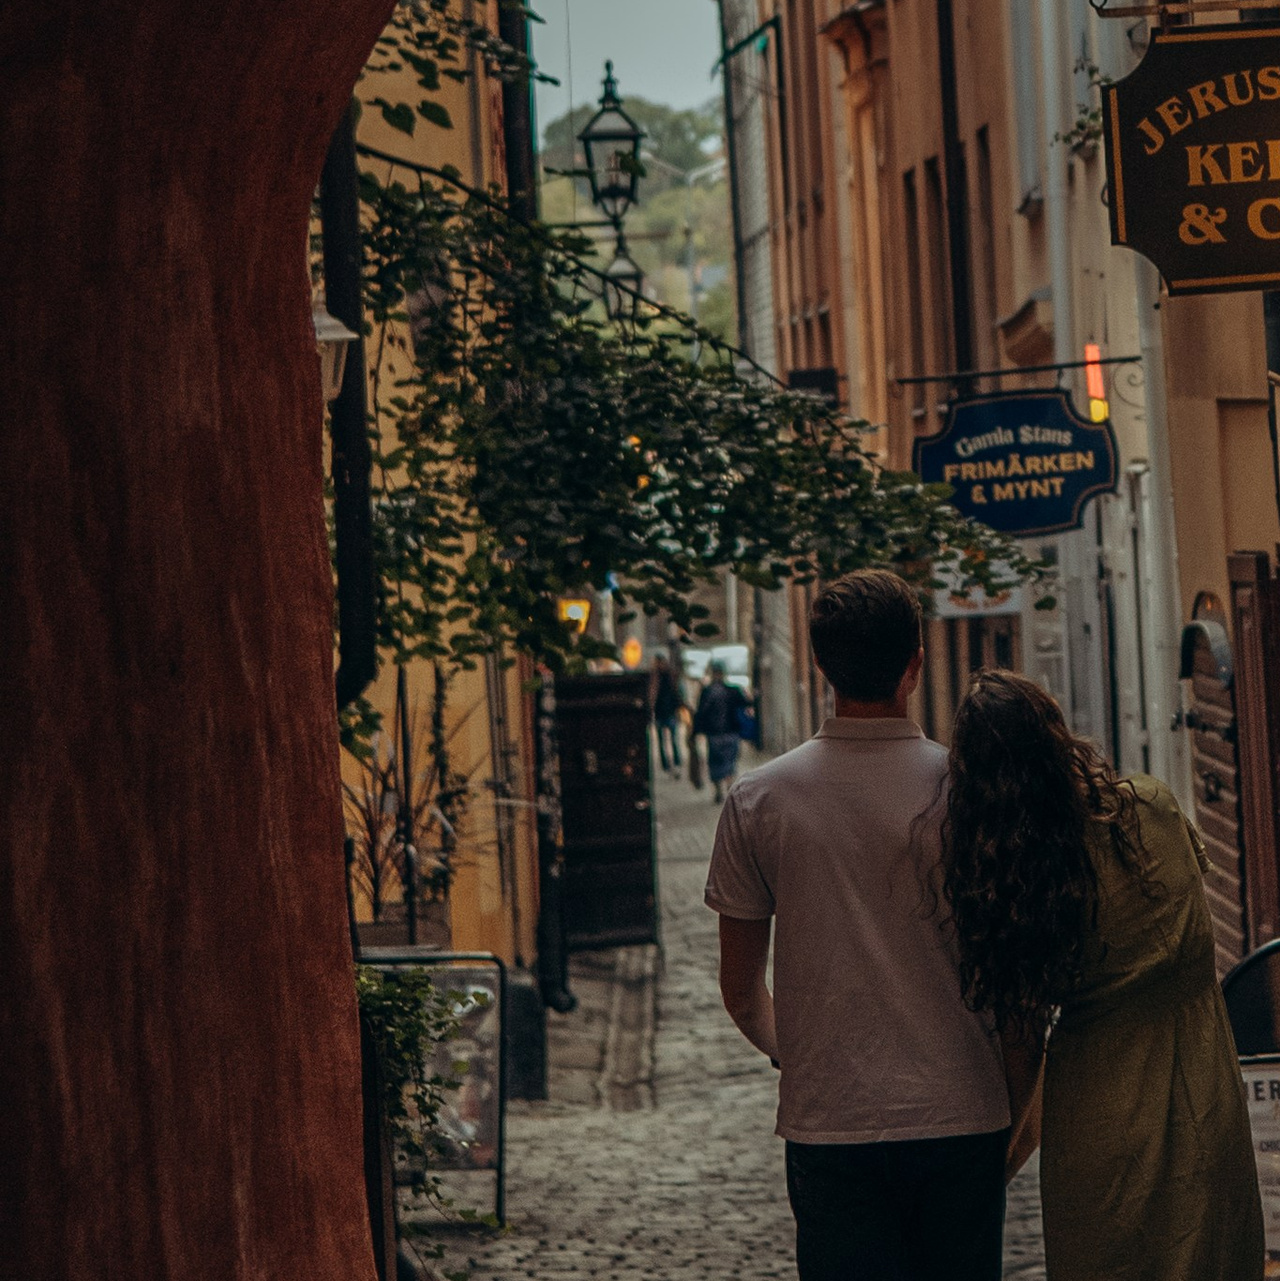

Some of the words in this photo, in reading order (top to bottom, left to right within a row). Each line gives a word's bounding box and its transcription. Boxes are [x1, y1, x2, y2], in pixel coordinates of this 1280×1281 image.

[1178, 202, 1228, 246] &
[954, 426, 1015, 458] Gamla
[1018, 424, 1074, 447] Stans
[970, 484, 988, 505] &
[992, 477, 1066, 502] MYNT
